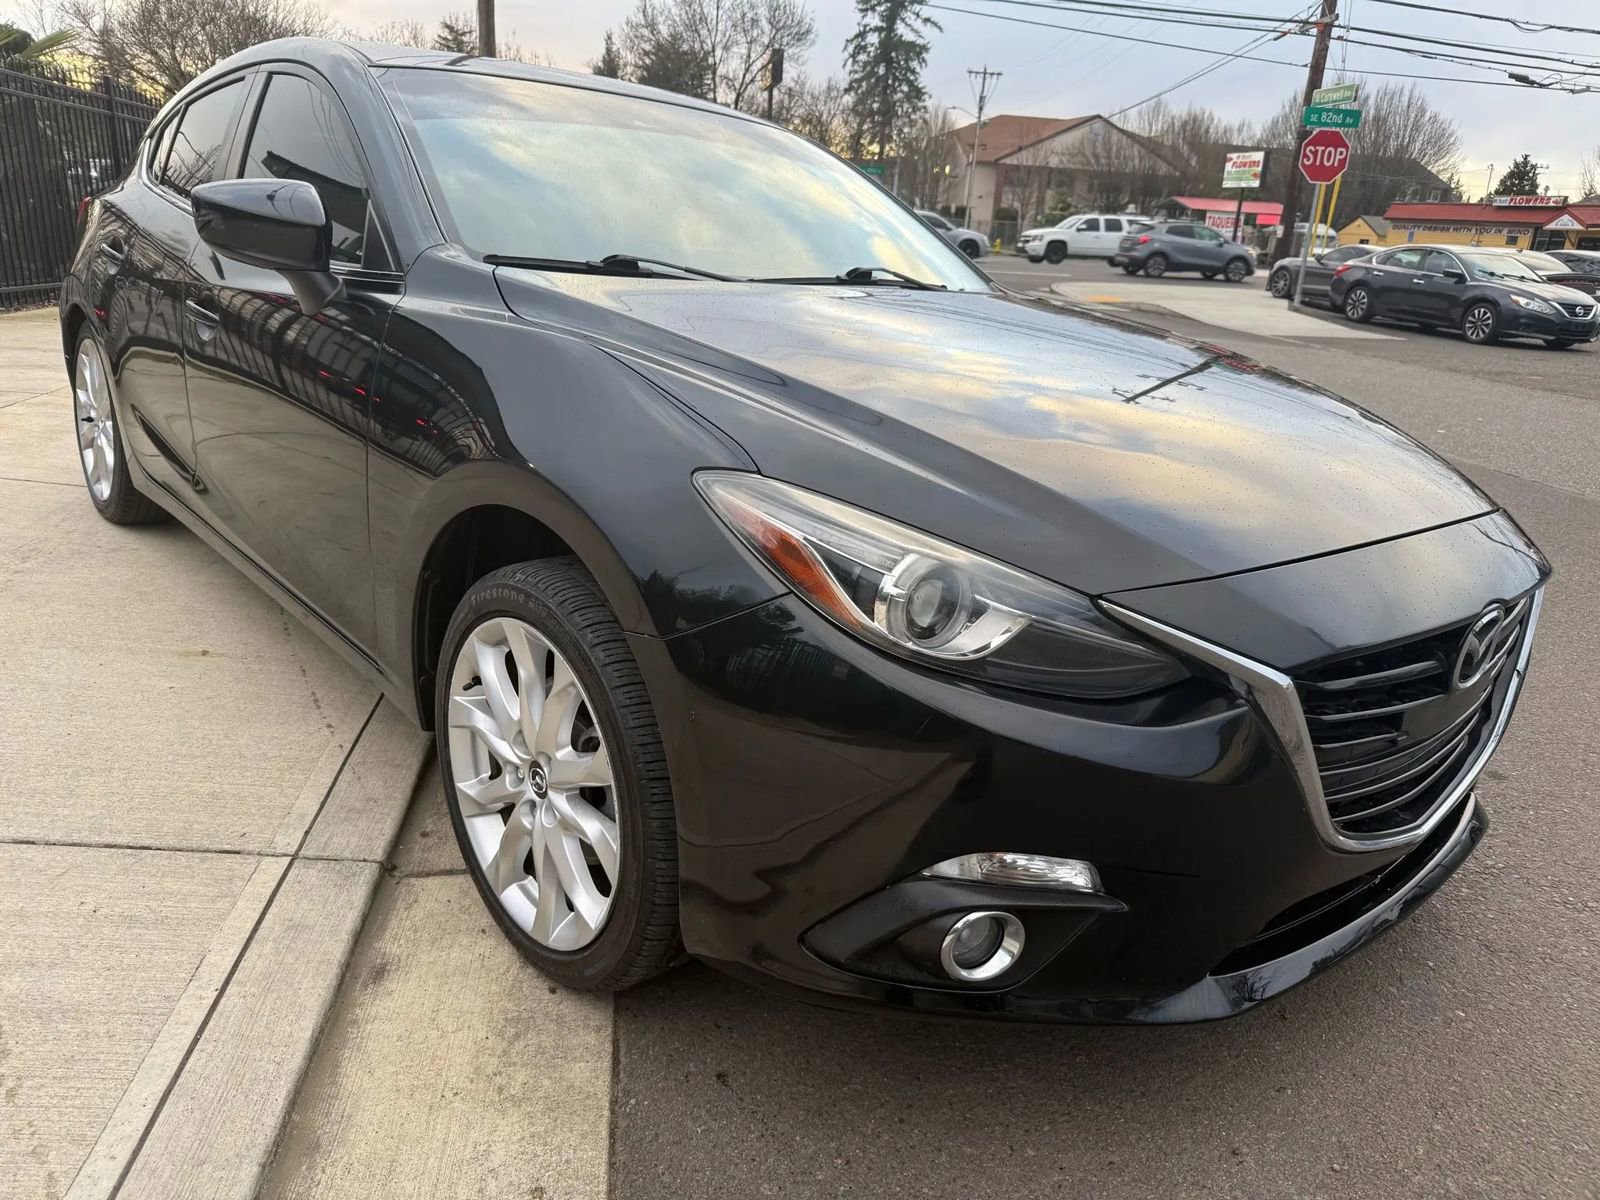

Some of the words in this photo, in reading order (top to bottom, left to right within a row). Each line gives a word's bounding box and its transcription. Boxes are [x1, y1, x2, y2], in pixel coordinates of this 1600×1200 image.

[1310, 113, 1319, 122] SE
[1321, 111, 1344, 124] 82nd
[1345, 116, 1354, 124] Av
[1303, 145, 1347, 167] STOP
[1231, 159, 1261, 169] FLOWERS
[1508, 196, 1551, 205] FLOWERS
[1391, 223, 1422, 232] QUALITY
[1422, 224, 1451, 233] DESIGN
[1452, 225, 1473, 233] WITH
[1474, 225, 1492, 235] YOU
[1494, 226, 1504, 235] IN
[1506, 226, 1531, 236] MIND
